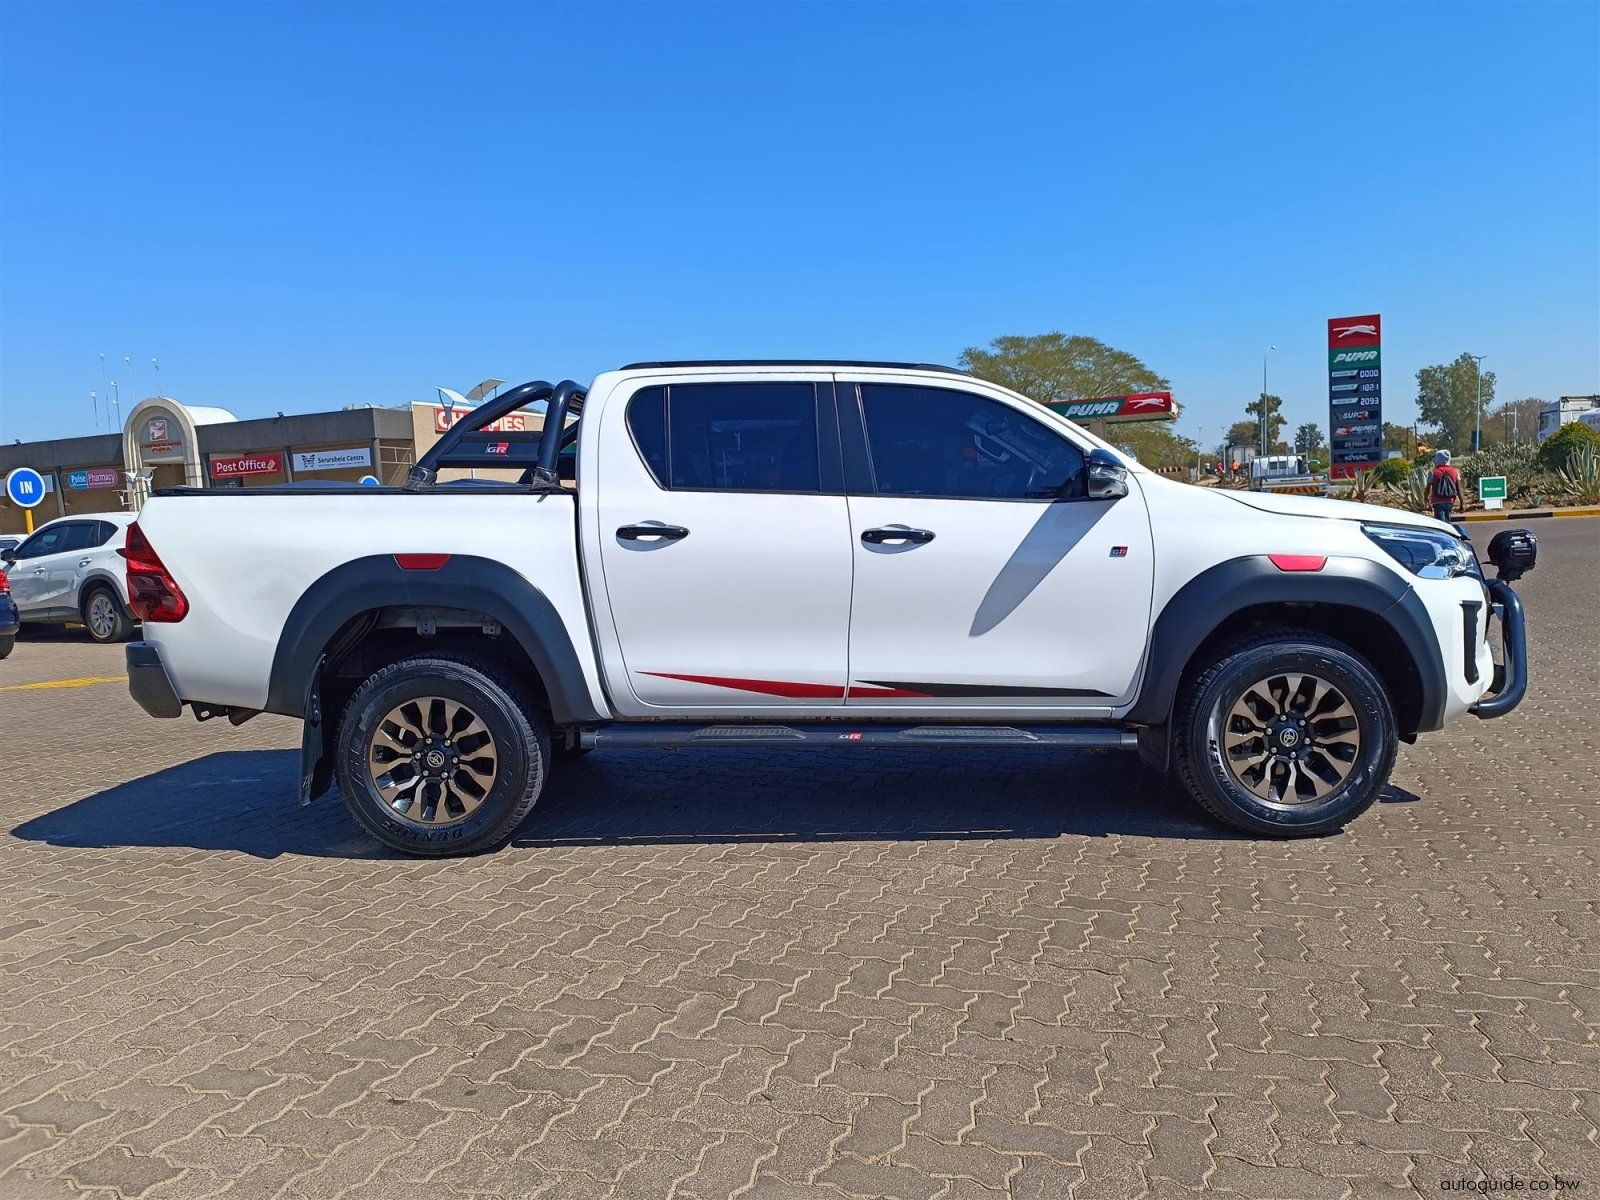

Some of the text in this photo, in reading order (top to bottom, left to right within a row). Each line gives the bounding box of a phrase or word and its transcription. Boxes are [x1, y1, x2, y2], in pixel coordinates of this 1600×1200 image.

[1333, 350, 1378, 363] PUMA
[1064, 401, 1119, 417] PUMA
[486, 444, 508, 453] GR
[216, 460, 266, 472] Post Office
[71, 475, 86, 483] Pulse
[88, 473, 114, 484] Pharmacy
[19, 480, 33, 494] IN
[1110, 547, 1127, 557] GR
